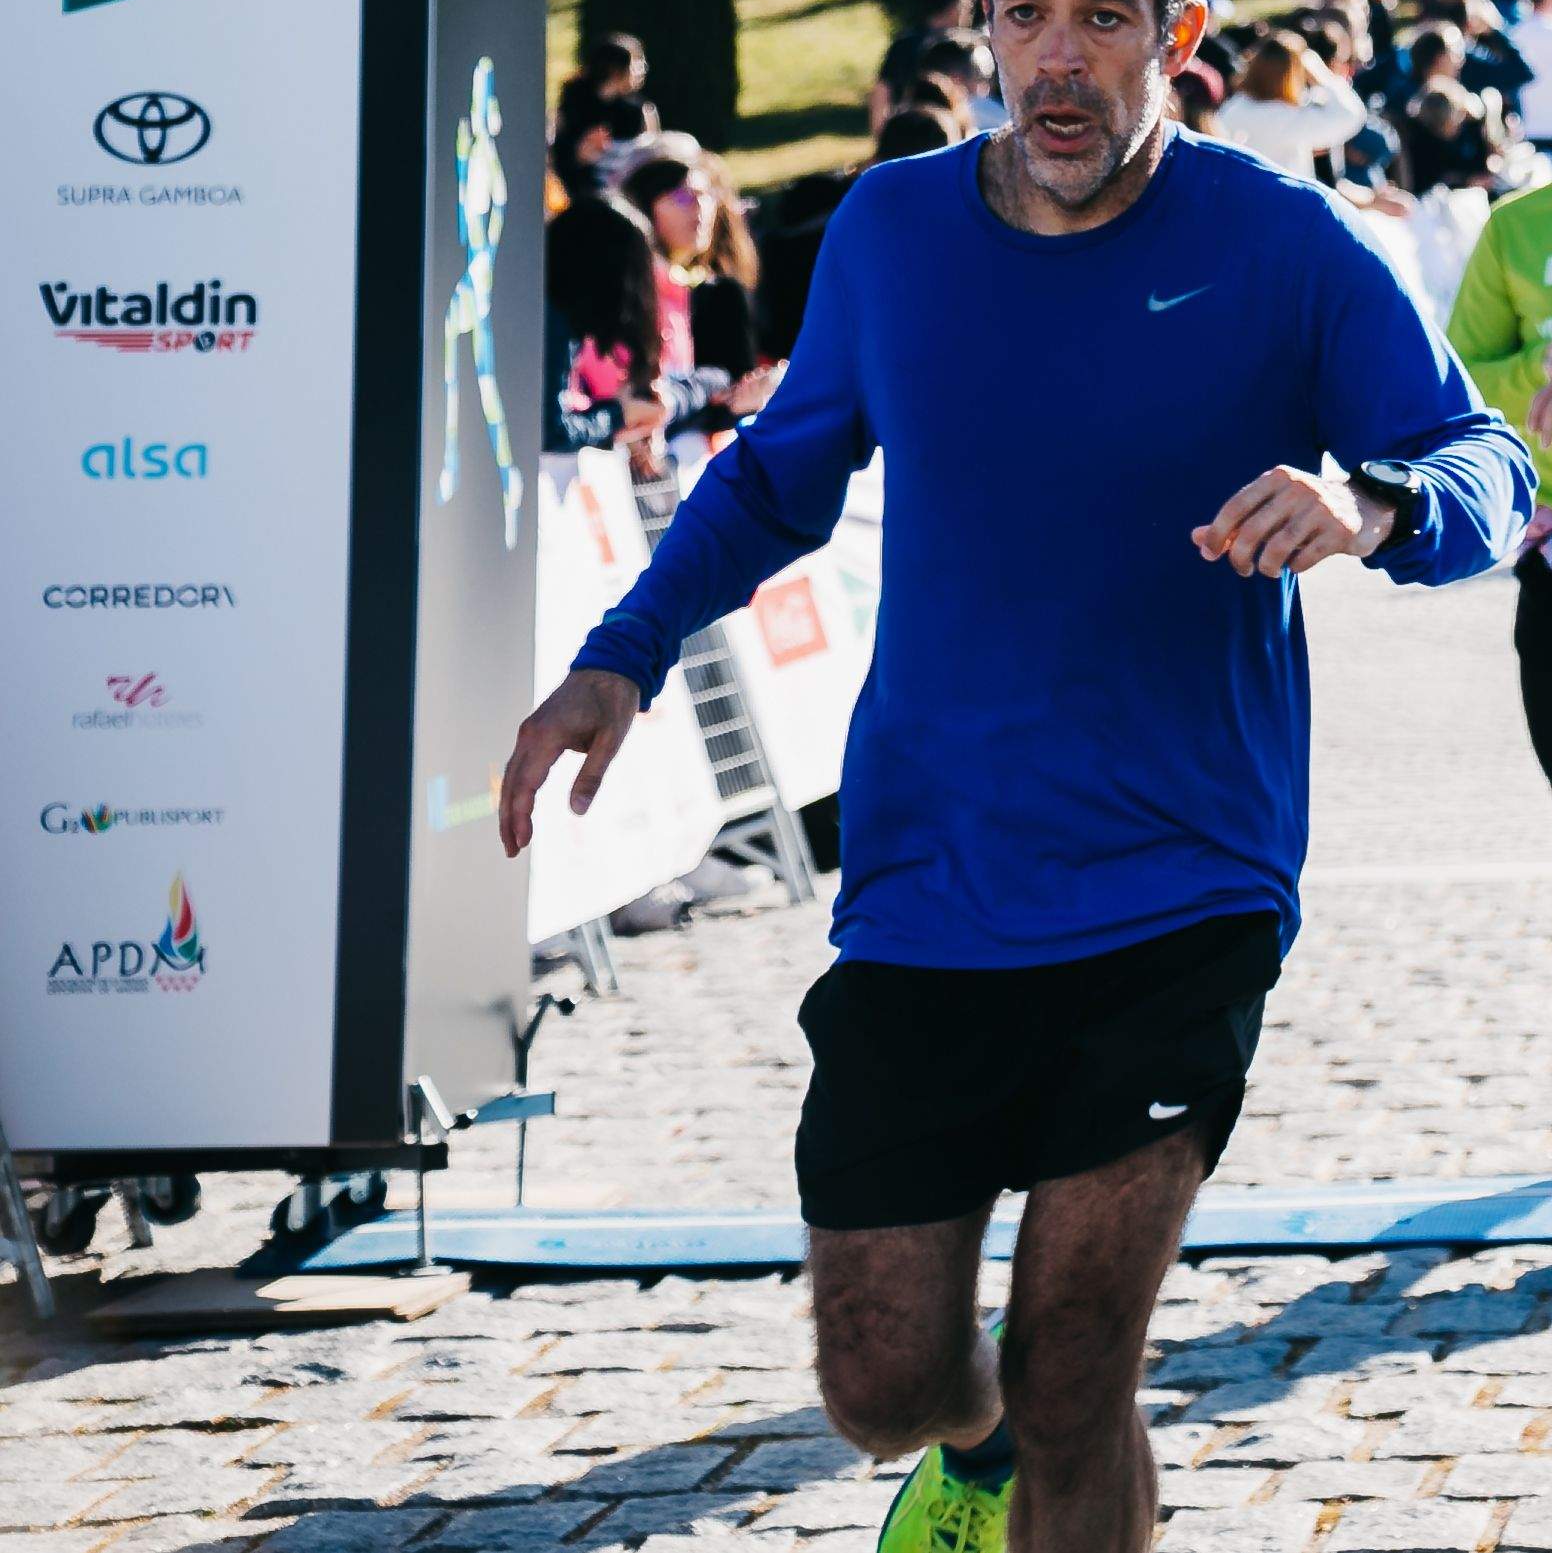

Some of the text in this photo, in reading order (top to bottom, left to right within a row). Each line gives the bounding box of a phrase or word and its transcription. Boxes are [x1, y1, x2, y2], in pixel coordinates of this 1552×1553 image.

[57, 185, 243, 206] SUPRA GAMBOA
[39, 280, 258, 326] Vitaldin
[156, 330, 256, 353] SPORT
[81, 437, 208, 480] alsa
